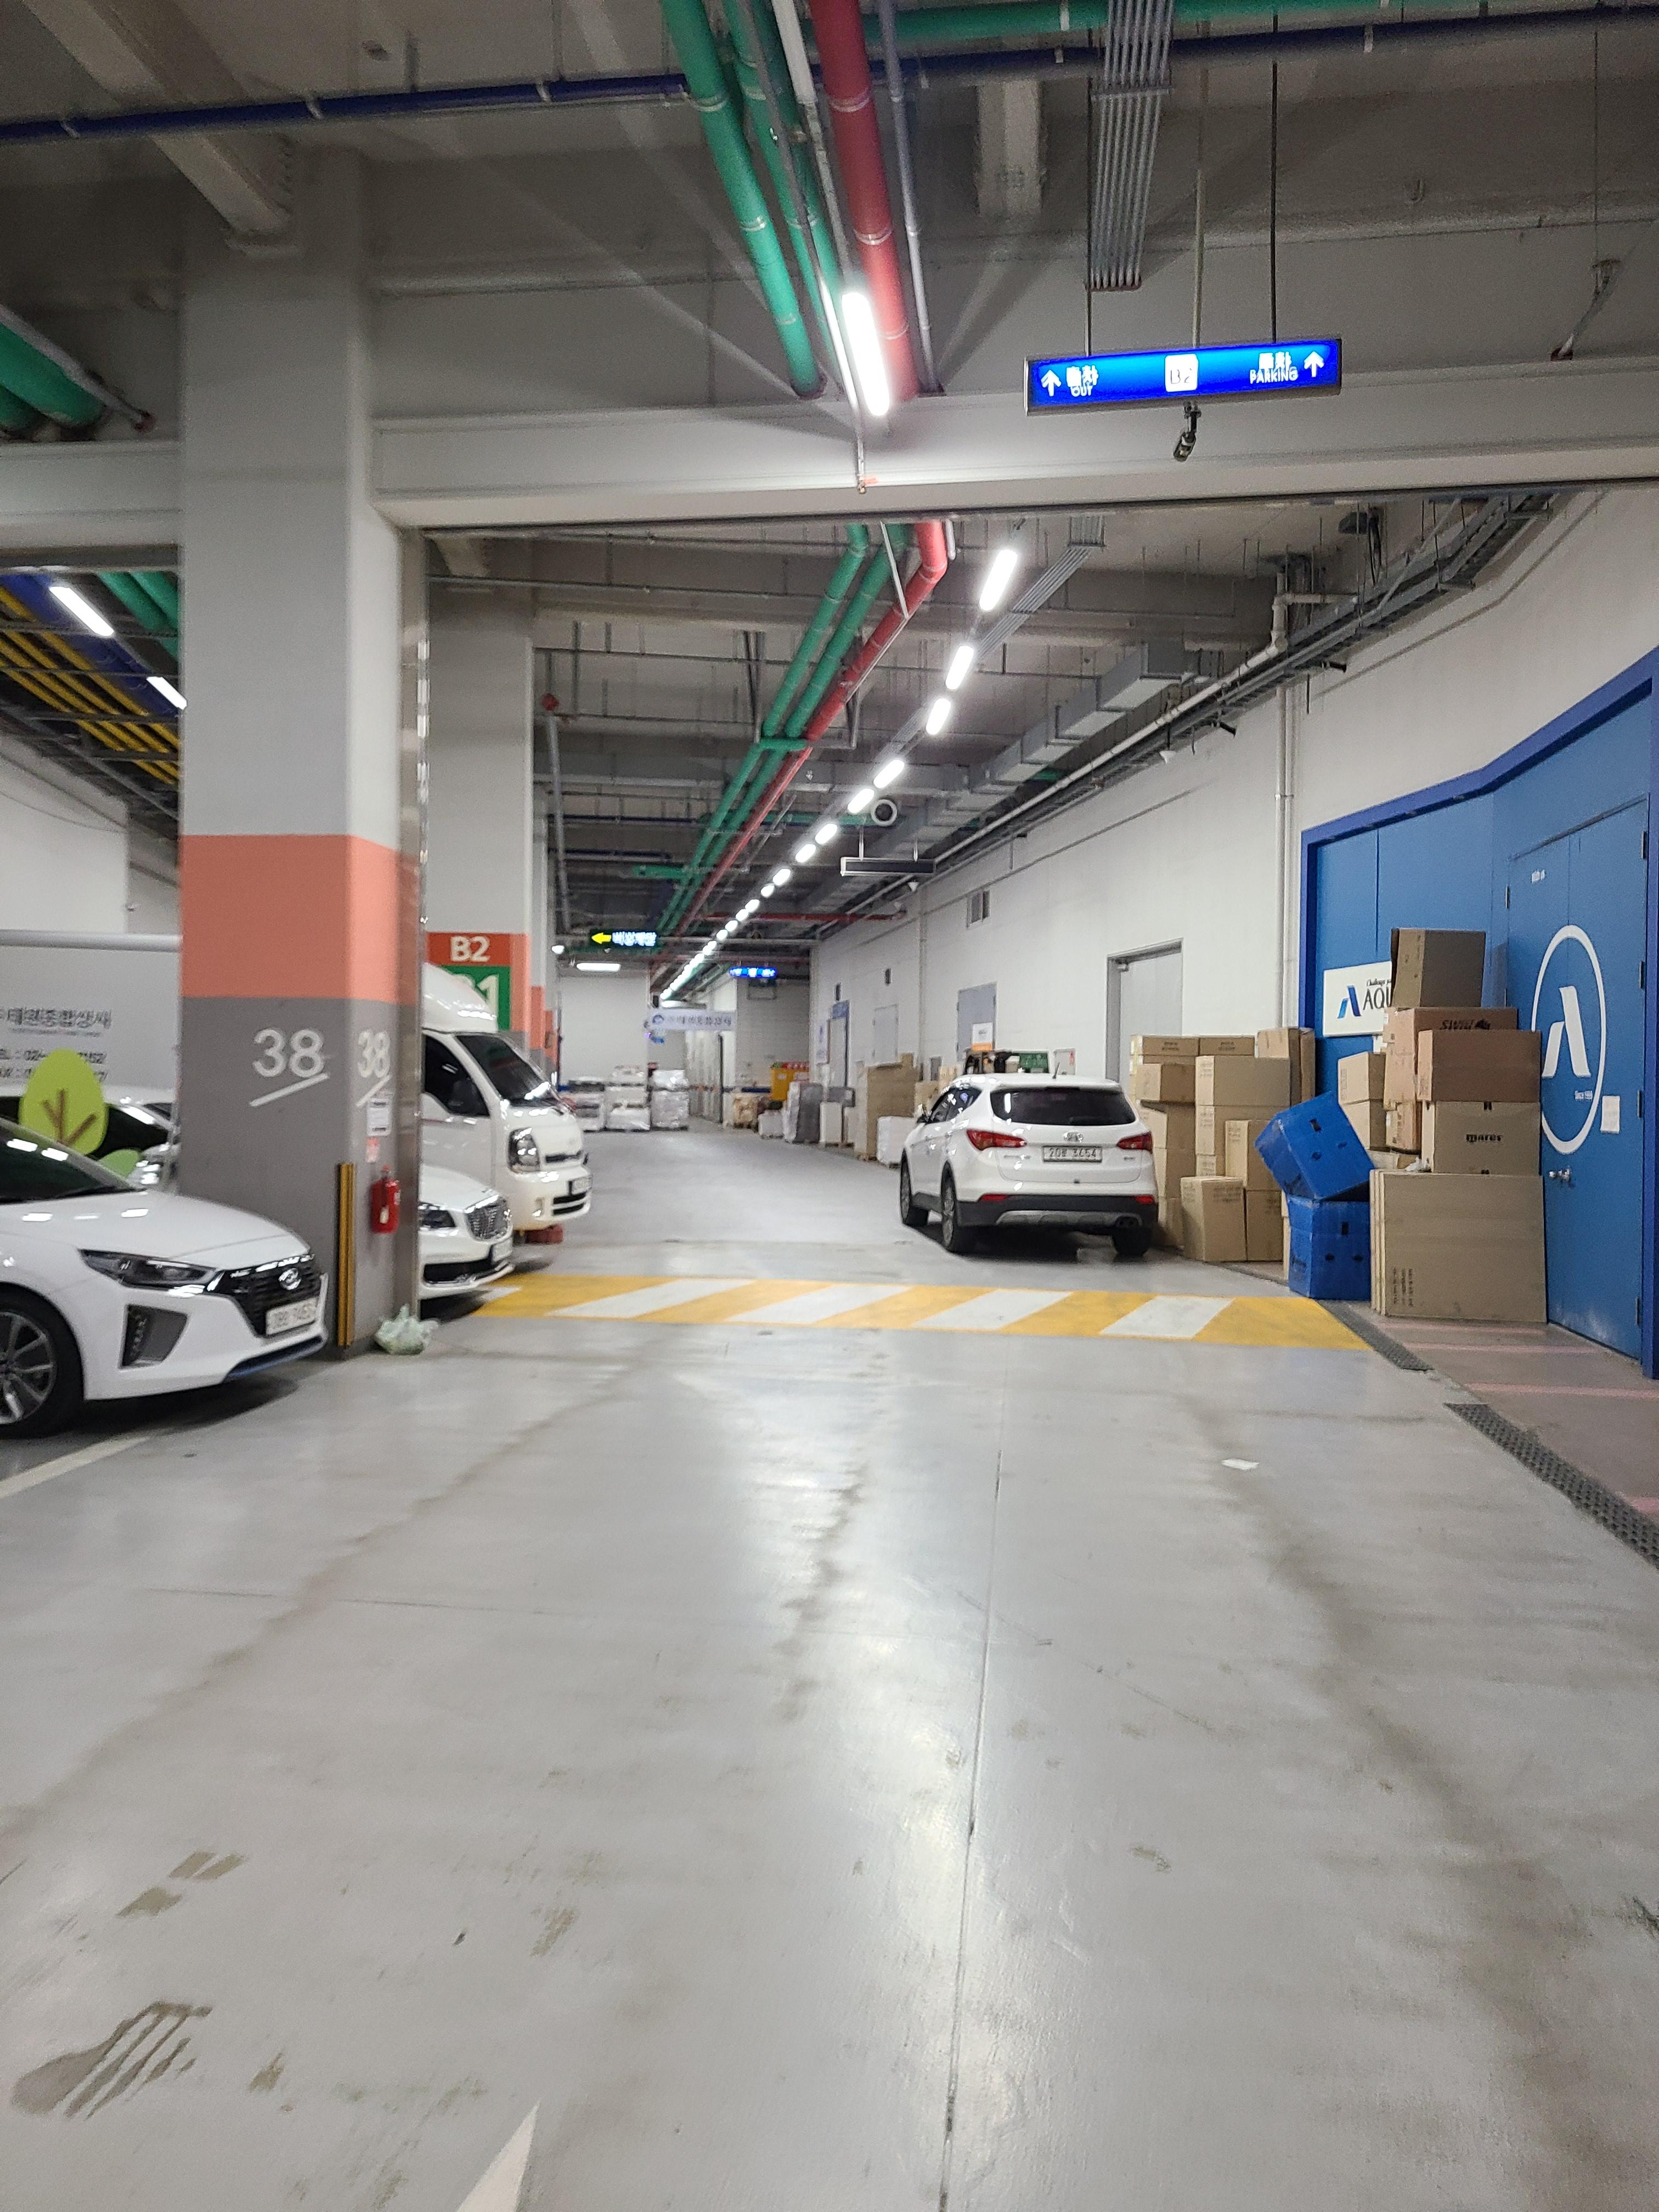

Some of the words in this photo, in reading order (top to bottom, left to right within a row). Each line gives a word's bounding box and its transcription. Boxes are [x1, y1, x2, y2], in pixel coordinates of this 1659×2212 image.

[1250, 366, 1299, 384] PARKING
[1070, 385, 1093, 397] OUT
[450, 935, 491, 962] B2
[252, 1028, 324, 1078] 38
[357, 1029, 391, 1079] 38
